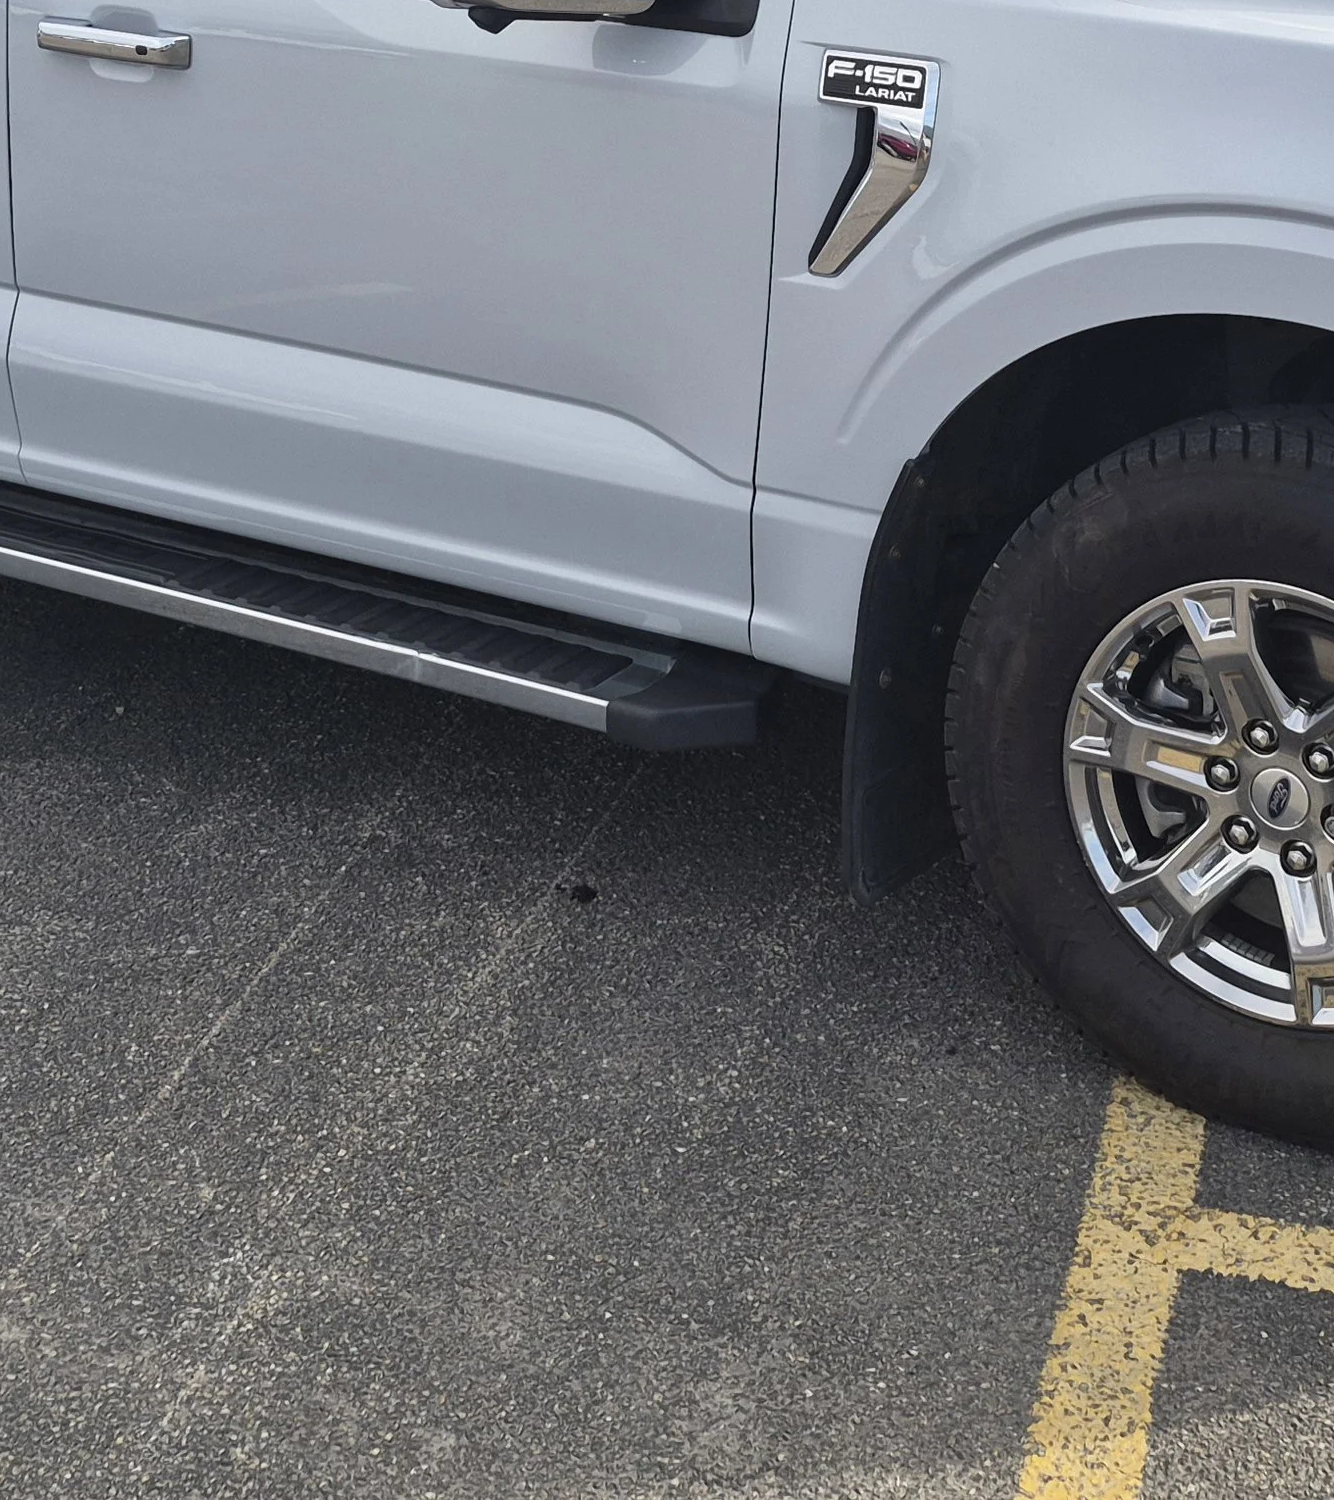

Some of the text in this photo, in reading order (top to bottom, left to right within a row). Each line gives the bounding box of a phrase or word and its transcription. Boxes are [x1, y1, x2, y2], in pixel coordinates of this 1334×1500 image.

[827, 59, 923, 89] F-150
[855, 85, 916, 102] LARIAT
[1270, 782, 1288, 814] Ford
